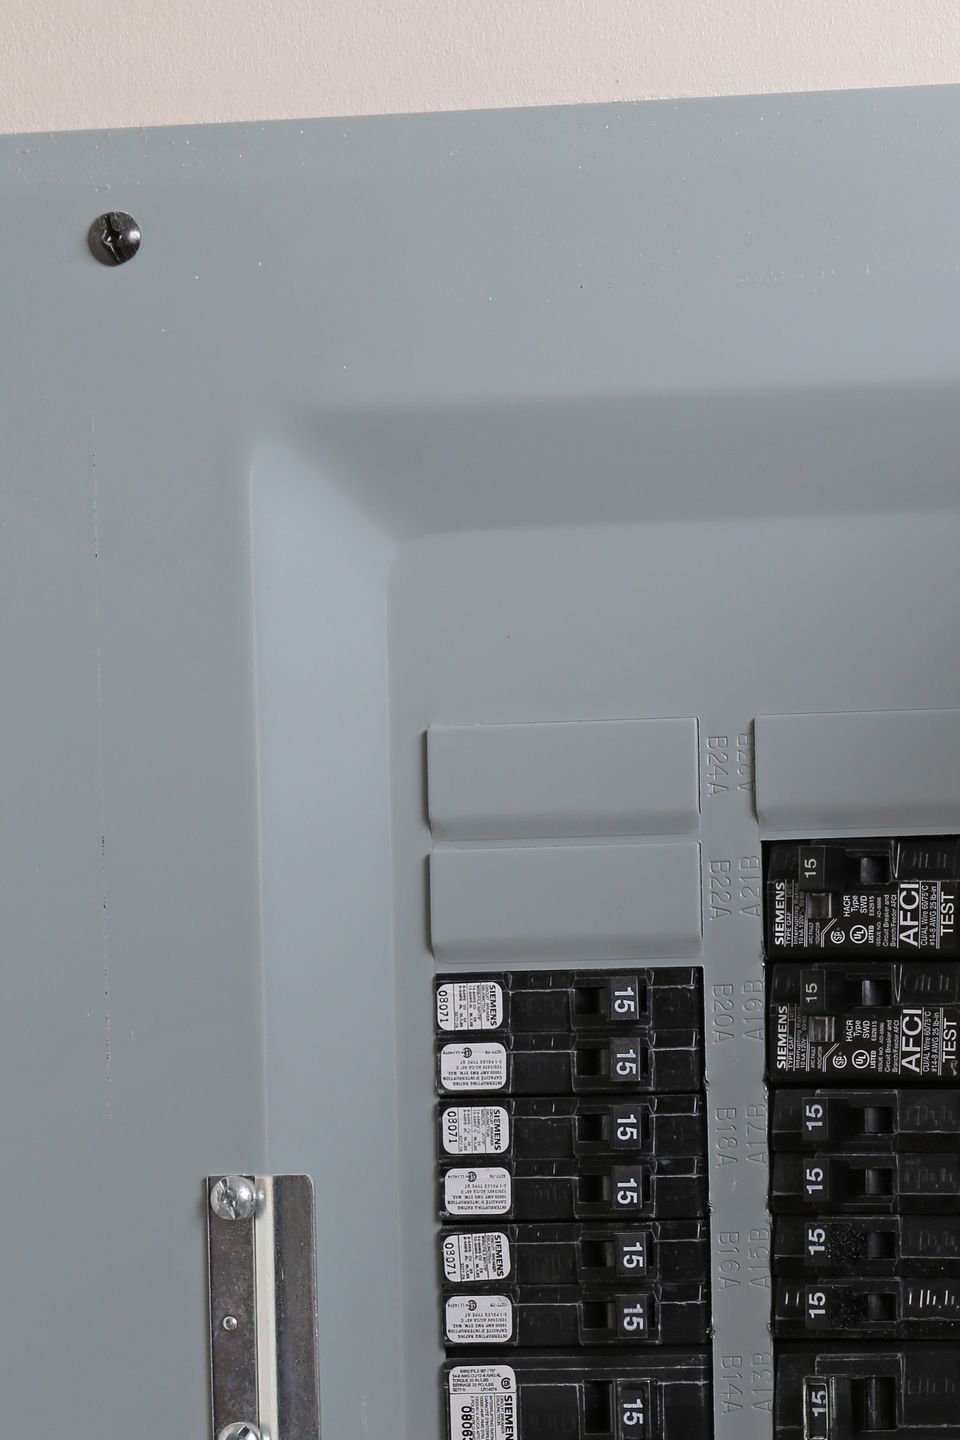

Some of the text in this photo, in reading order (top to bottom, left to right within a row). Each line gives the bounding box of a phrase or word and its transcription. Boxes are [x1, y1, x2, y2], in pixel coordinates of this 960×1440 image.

[706, 735, 728, 798] B24A
[804, 858, 817, 878] 15
[709, 860, 731, 920] B22A
[738, 856, 761, 918] A21B
[774, 882, 785, 945] SIEMENS
[843, 895, 851, 917] HACR
[851, 895, 859, 912] Type
[860, 895, 868, 914] SWD
[900, 883, 919, 947] AFCI
[930, 901, 937, 909] 25
[940, 891, 955, 936] TEST
[489, 984, 498, 1026] SIEMENS
[614, 986, 635, 1013] 15
[805, 983, 818, 1003] 15
[711, 984, 735, 1045] B20A
[742, 980, 764, 1041] A19B
[777, 1005, 788, 1069] SIEMENS
[845, 1020, 853, 1042] HACR
[853, 1020, 861, 1037] Type
[862, 1020, 870, 1039] SWD
[901, 1009, 922, 1073] AFCI
[932, 1028, 939, 1036] 25
[942, 1017, 957, 1063] TEST
[616, 1049, 637, 1076] 15
[493, 1108, 501, 1151] SIEMENS
[617, 1114, 637, 1141] 15
[805, 1104, 823, 1131] 15
[715, 1106, 738, 1168] B18A
[745, 1104, 768, 1165] A17B
[617, 1178, 638, 1205] 15
[806, 1167, 824, 1194] 15
[494, 1234, 504, 1277] SIEMENS
[623, 1242, 644, 1269] 15
[808, 1228, 826, 1256] 15
[718, 1231, 740, 1292] B16A
[748, 1228, 770, 1289] A15B
[623, 1303, 644, 1331] 15
[808, 1291, 826, 1319] 15
[720, 1354, 744, 1416] B14A
[751, 1353, 773, 1412] A13B
[623, 1398, 643, 1426] 15
[811, 1390, 827, 1417] 15
